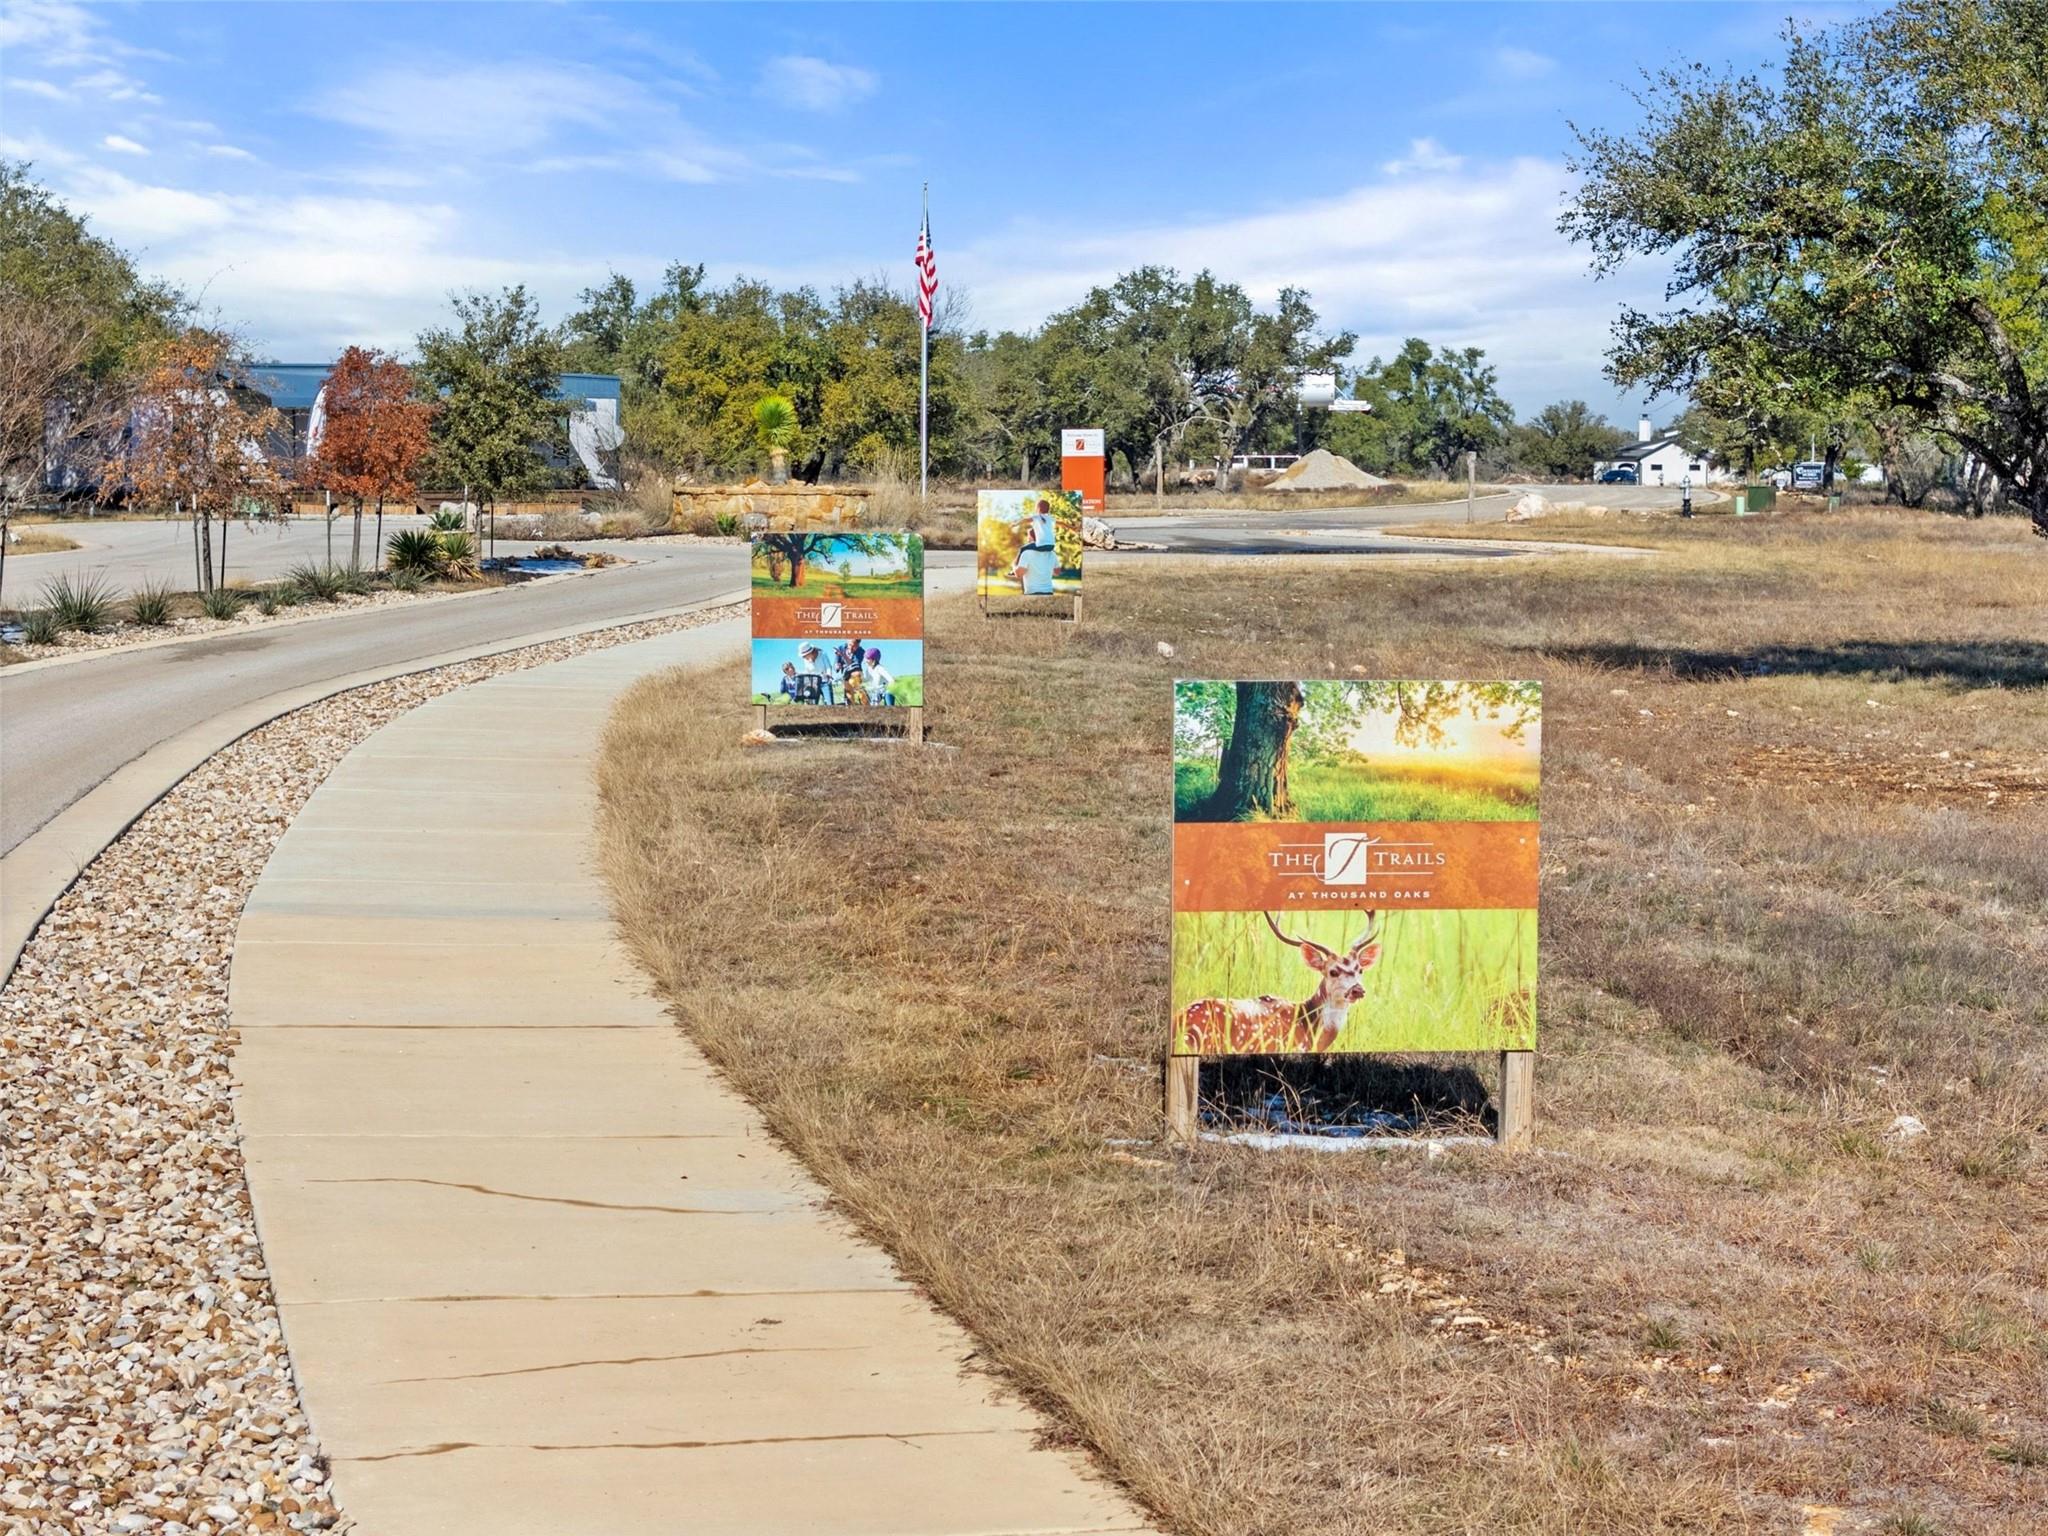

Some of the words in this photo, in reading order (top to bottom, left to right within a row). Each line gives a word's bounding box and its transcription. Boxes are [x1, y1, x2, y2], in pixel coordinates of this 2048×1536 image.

[1268, 852, 1313, 868] THE
[1374, 851, 1446, 866] TRAILS
[1311, 891, 1388, 899] THOUSAND
[1394, 891, 1431, 899] OAKS
